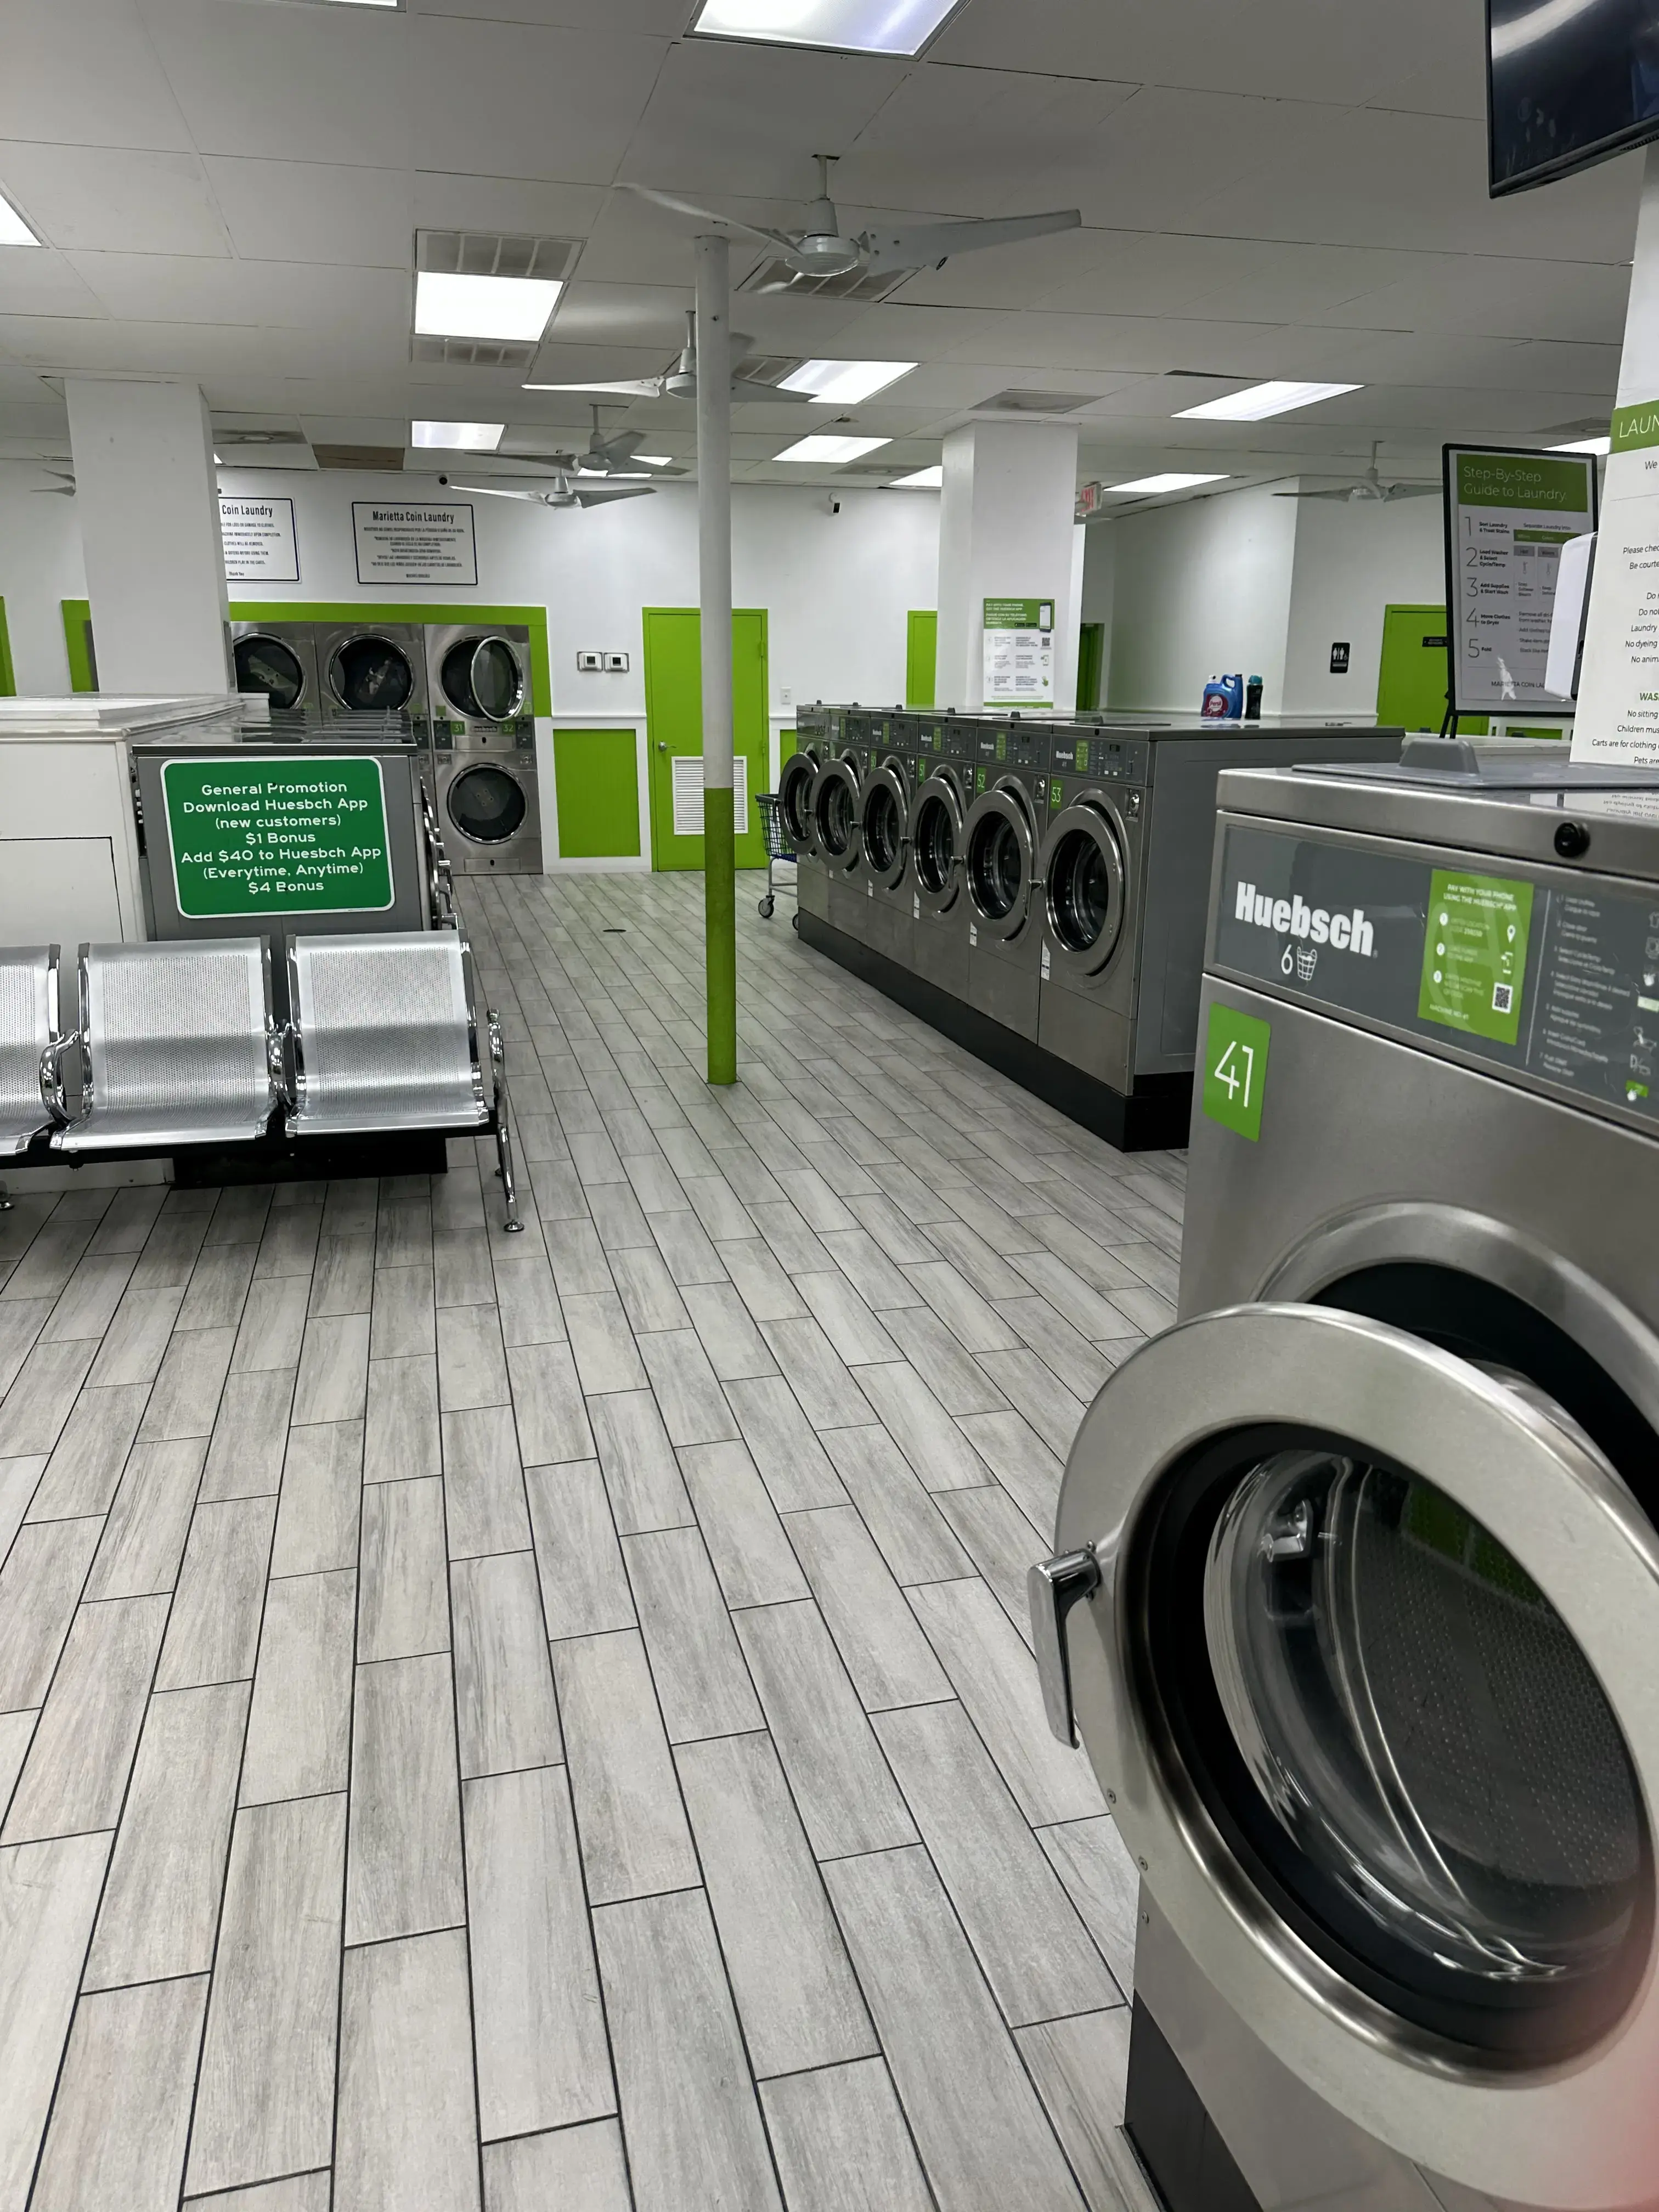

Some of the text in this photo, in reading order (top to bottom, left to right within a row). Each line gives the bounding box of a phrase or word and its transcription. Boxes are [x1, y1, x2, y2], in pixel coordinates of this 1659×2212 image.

[1645, 460, 1657, 470] We
[1464, 466, 1542, 484] Step-By-Step
[1464, 483, 1500, 496] Guide
[1502, 487, 1514, 496] to
[222, 504, 273, 518] Coin Laundry
[373, 511, 454, 524] Marietta Coin Laundry
[1464, 516, 1471, 537] 1
[1466, 547, 1478, 567] 2
[1466, 577, 1478, 597] 3
[1466, 608, 1480, 628] 4
[1631, 624, 1657, 633] Laundry
[1468, 639, 1480, 658] 5
[1635, 640, 1657, 649] dyeing
[1631, 656, 1640, 664] No
[1638, 710, 1658, 719] sitting
[1617, 725, 1644, 733] Children
[1629, 741, 1656, 751] clothing
[201, 781, 347, 796] General Promotion
[977, 774, 985, 788] 52
[1051, 787, 1061, 803] 53
[183, 797, 368, 813] Download Huesbch App
[215, 814, 341, 830] (new customers)
[245, 832, 316, 845] $1 Bonus
[181, 847, 381, 864] Add $40 to Huesbch App
[203, 862, 363, 881] (Everytime, Anytime)
[248, 881, 324, 894] $4 Bonus
[1235, 881, 1374, 957] Huebsch
[1281, 944, 1293, 975] 6
[1214, 1041, 1254, 1107] 41
